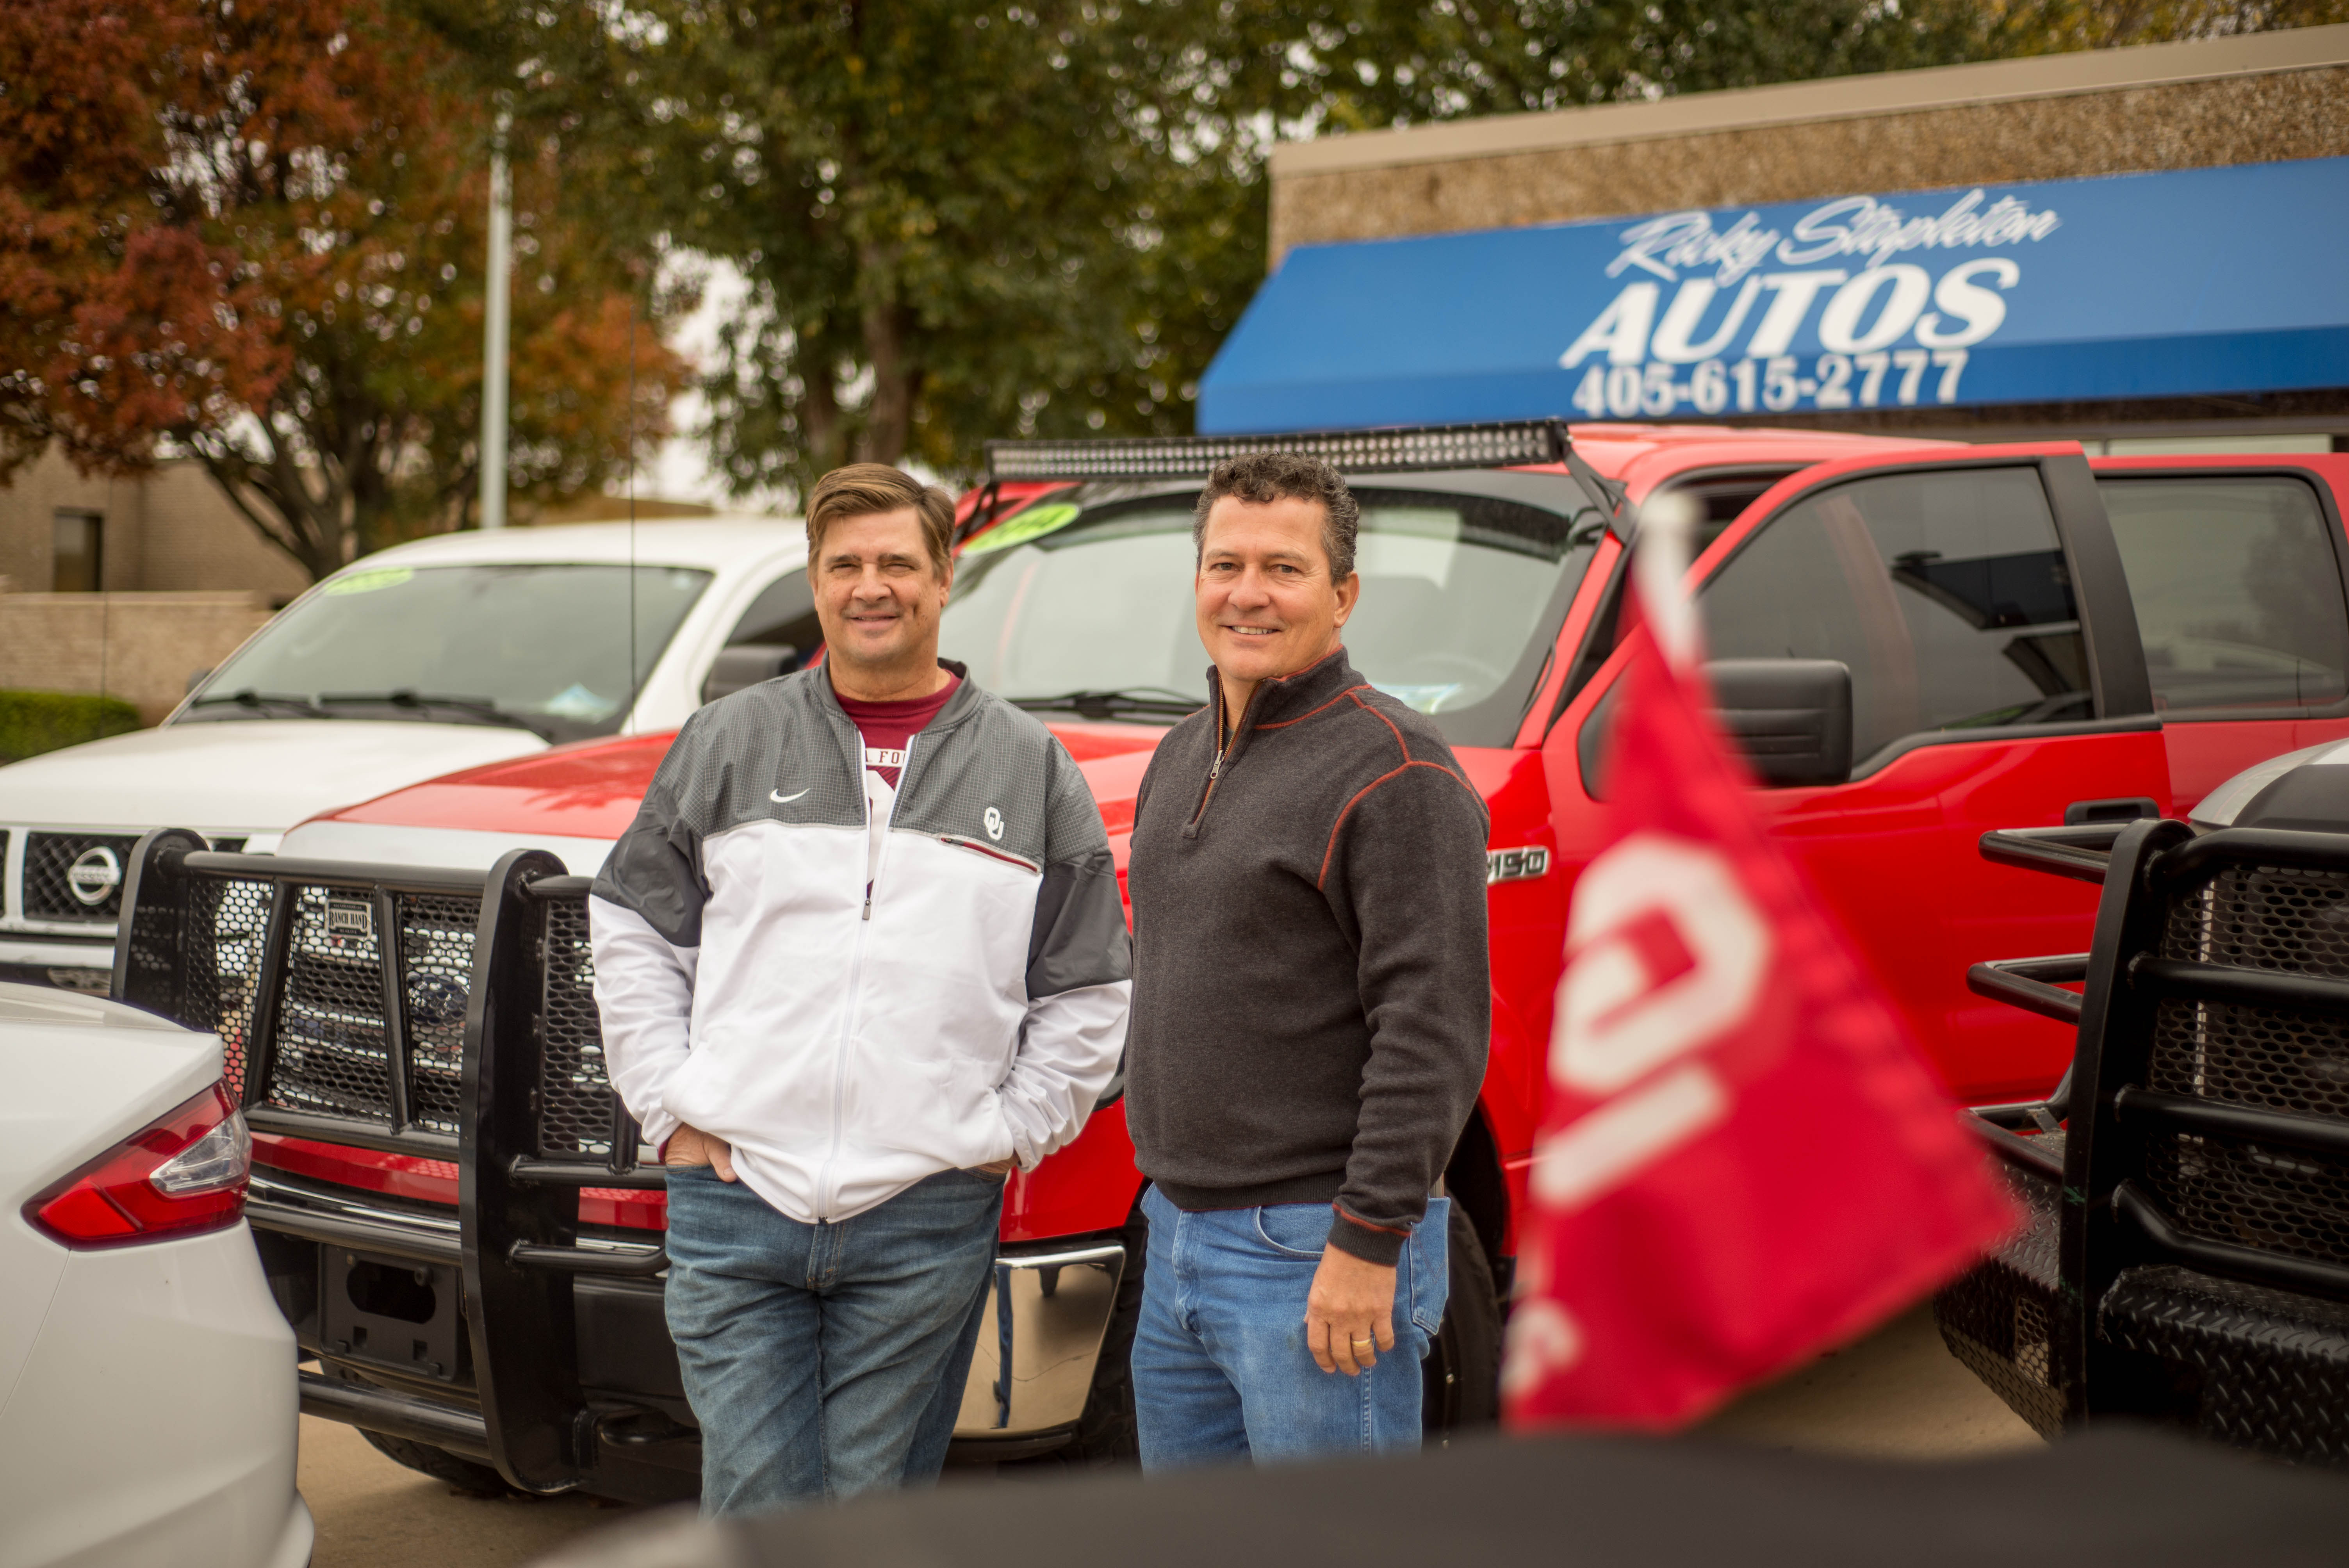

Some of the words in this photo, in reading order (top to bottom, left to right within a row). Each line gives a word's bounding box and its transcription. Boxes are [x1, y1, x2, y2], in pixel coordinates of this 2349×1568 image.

[1777, 187, 2060, 270] Stapleton
[1560, 257, 2020, 369] AUTOS
[1572, 349, 1969, 417] 405-615-2777
[879, 750, 906, 764] FO
[1486, 846, 1550, 883] 150
[329, 911, 349, 927] RANCH
[350, 913, 367, 929] HAND
